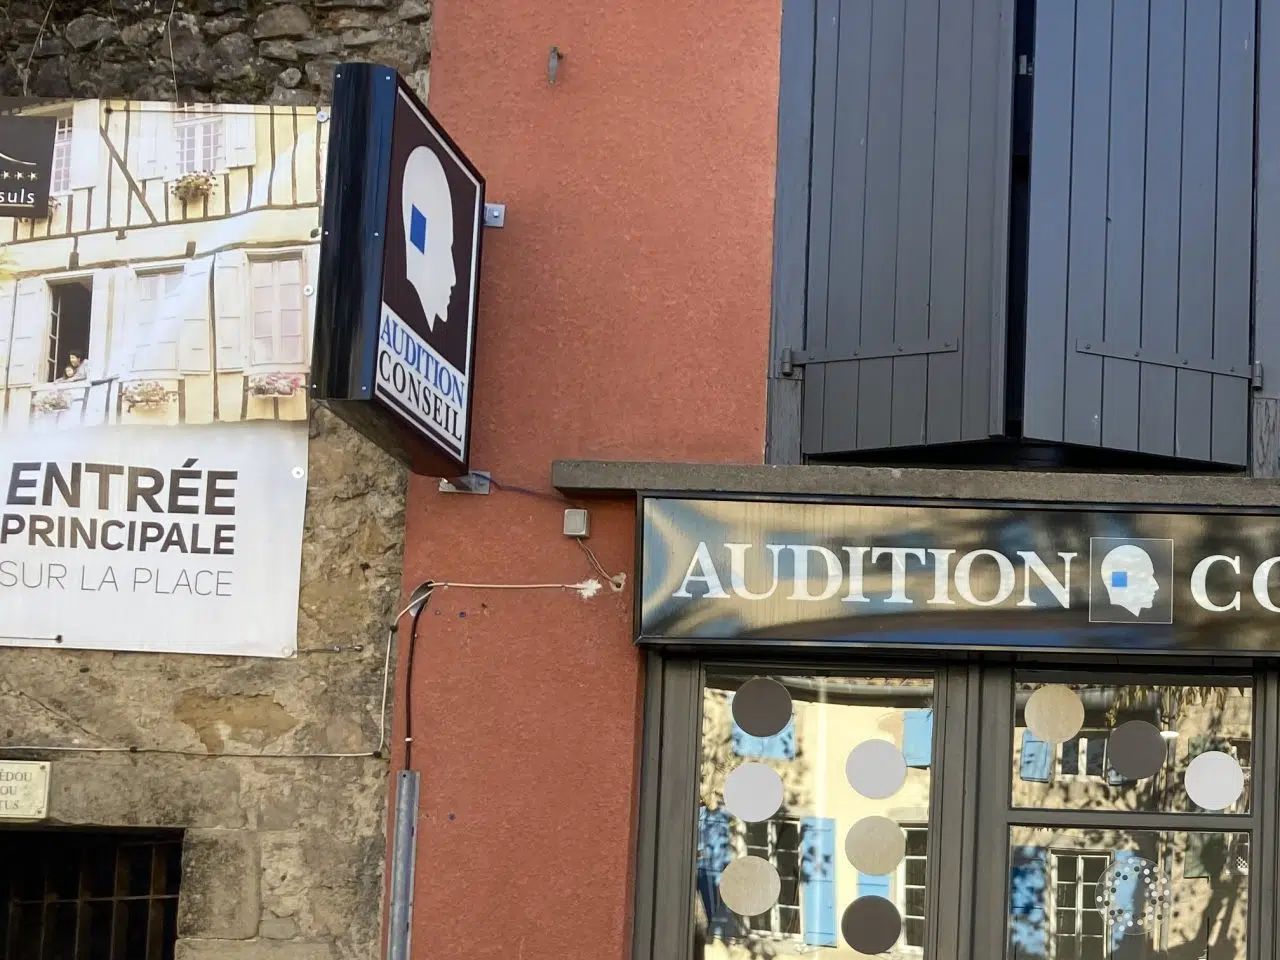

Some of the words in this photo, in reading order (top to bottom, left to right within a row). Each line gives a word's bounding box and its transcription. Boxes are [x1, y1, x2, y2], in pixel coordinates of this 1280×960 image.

[381, 314, 465, 409] AUDITION
[379, 350, 462, 441] CONSEIL
[6, 458, 238, 515] ENTRÉE
[0, 513, 236, 555] PRINCIPALE
[0, 560, 67, 590] SUR
[81, 565, 119, 593] LA
[133, 568, 233, 597] PLACE
[671, 540, 1078, 609] AUDITION
